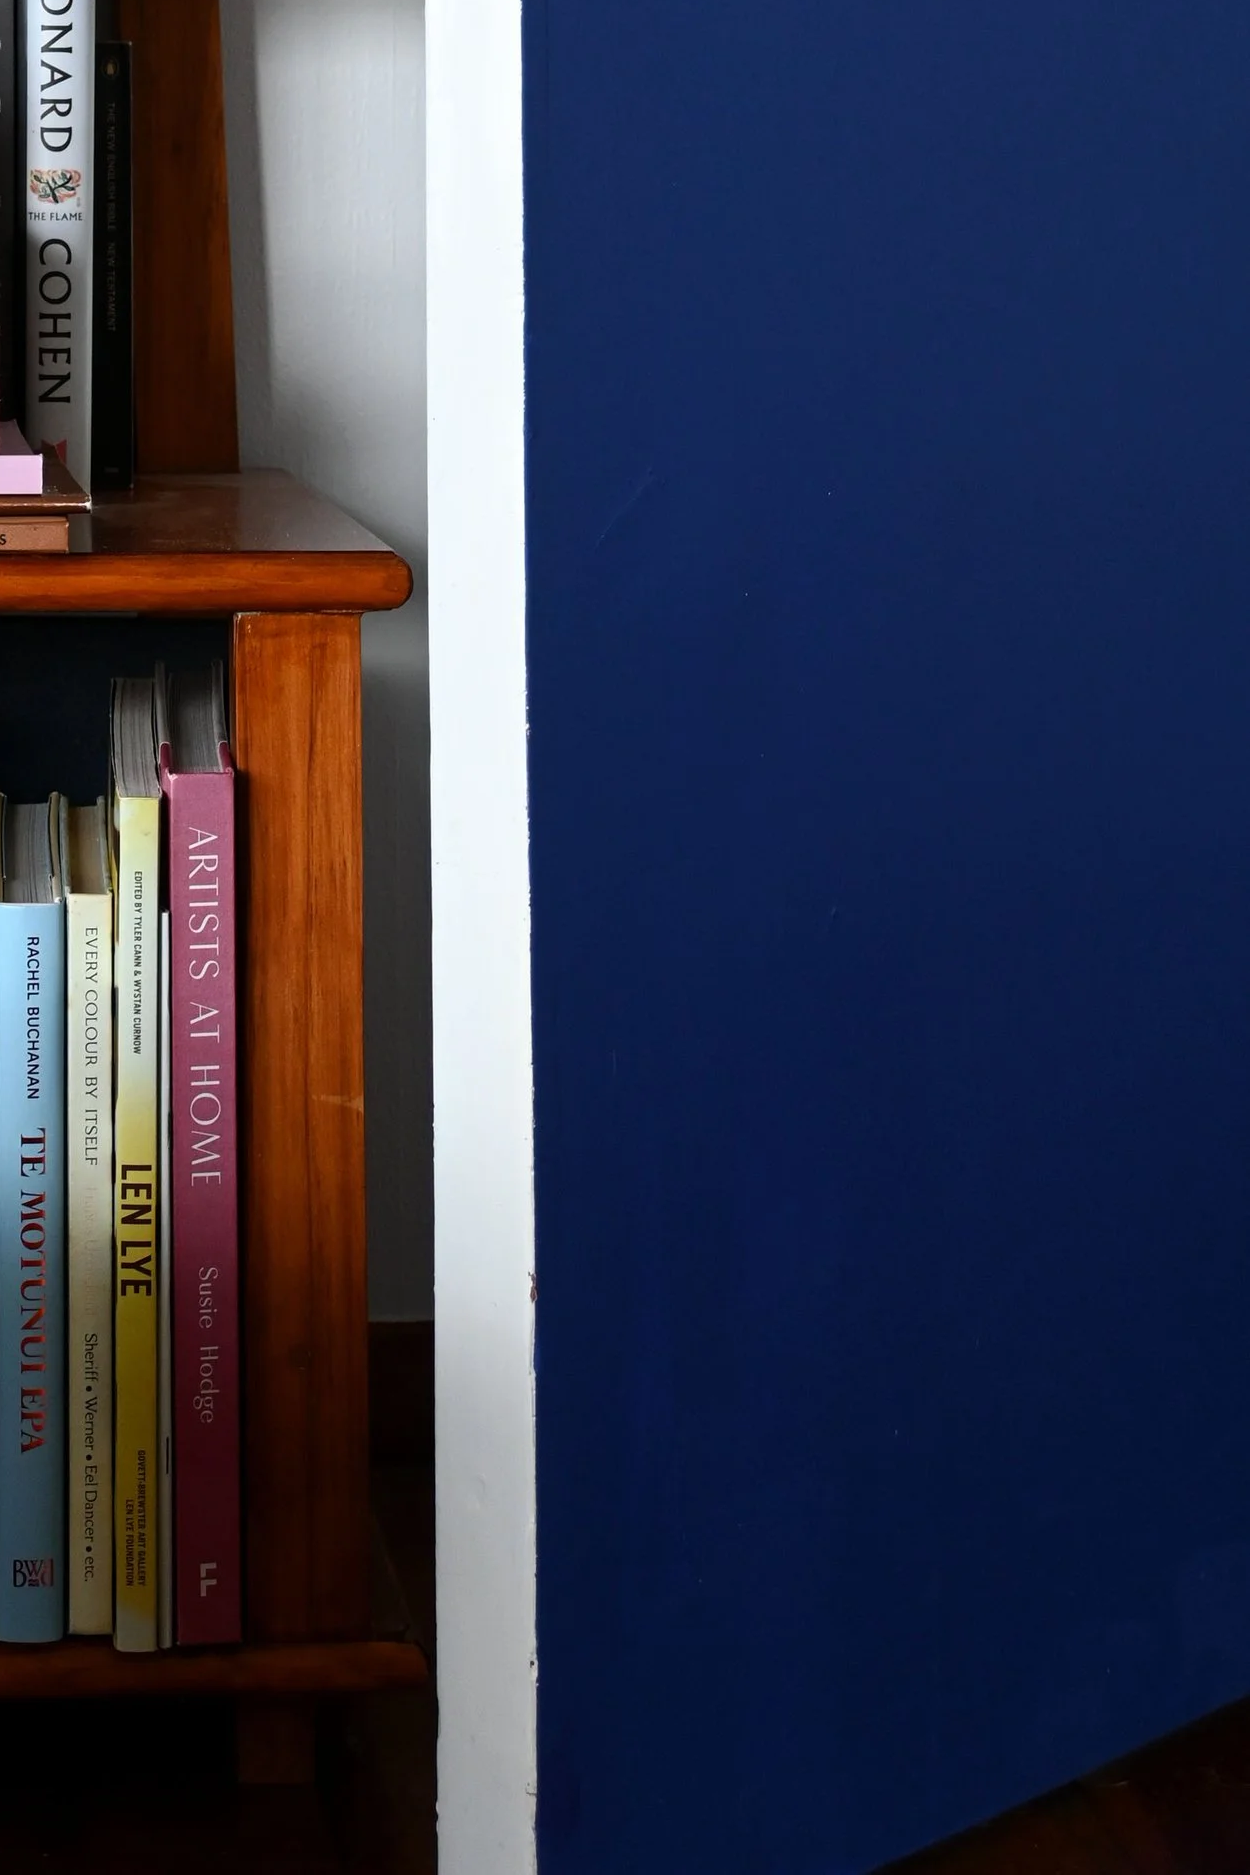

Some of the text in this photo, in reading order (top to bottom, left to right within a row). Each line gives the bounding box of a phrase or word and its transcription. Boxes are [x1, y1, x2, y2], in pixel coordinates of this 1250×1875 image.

[38, 237, 73, 404] COHEN
[84, 927, 99, 1166] EVERY COLOUR BY ITSELF
[188, 826, 222, 1423] ARTISTS AT HOME Susie Hodge
[18, 936, 46, 1453] RACHEL BUCHANAN TE MOTUNUI EPA
[119, 1164, 153, 1297] LEN LYE
